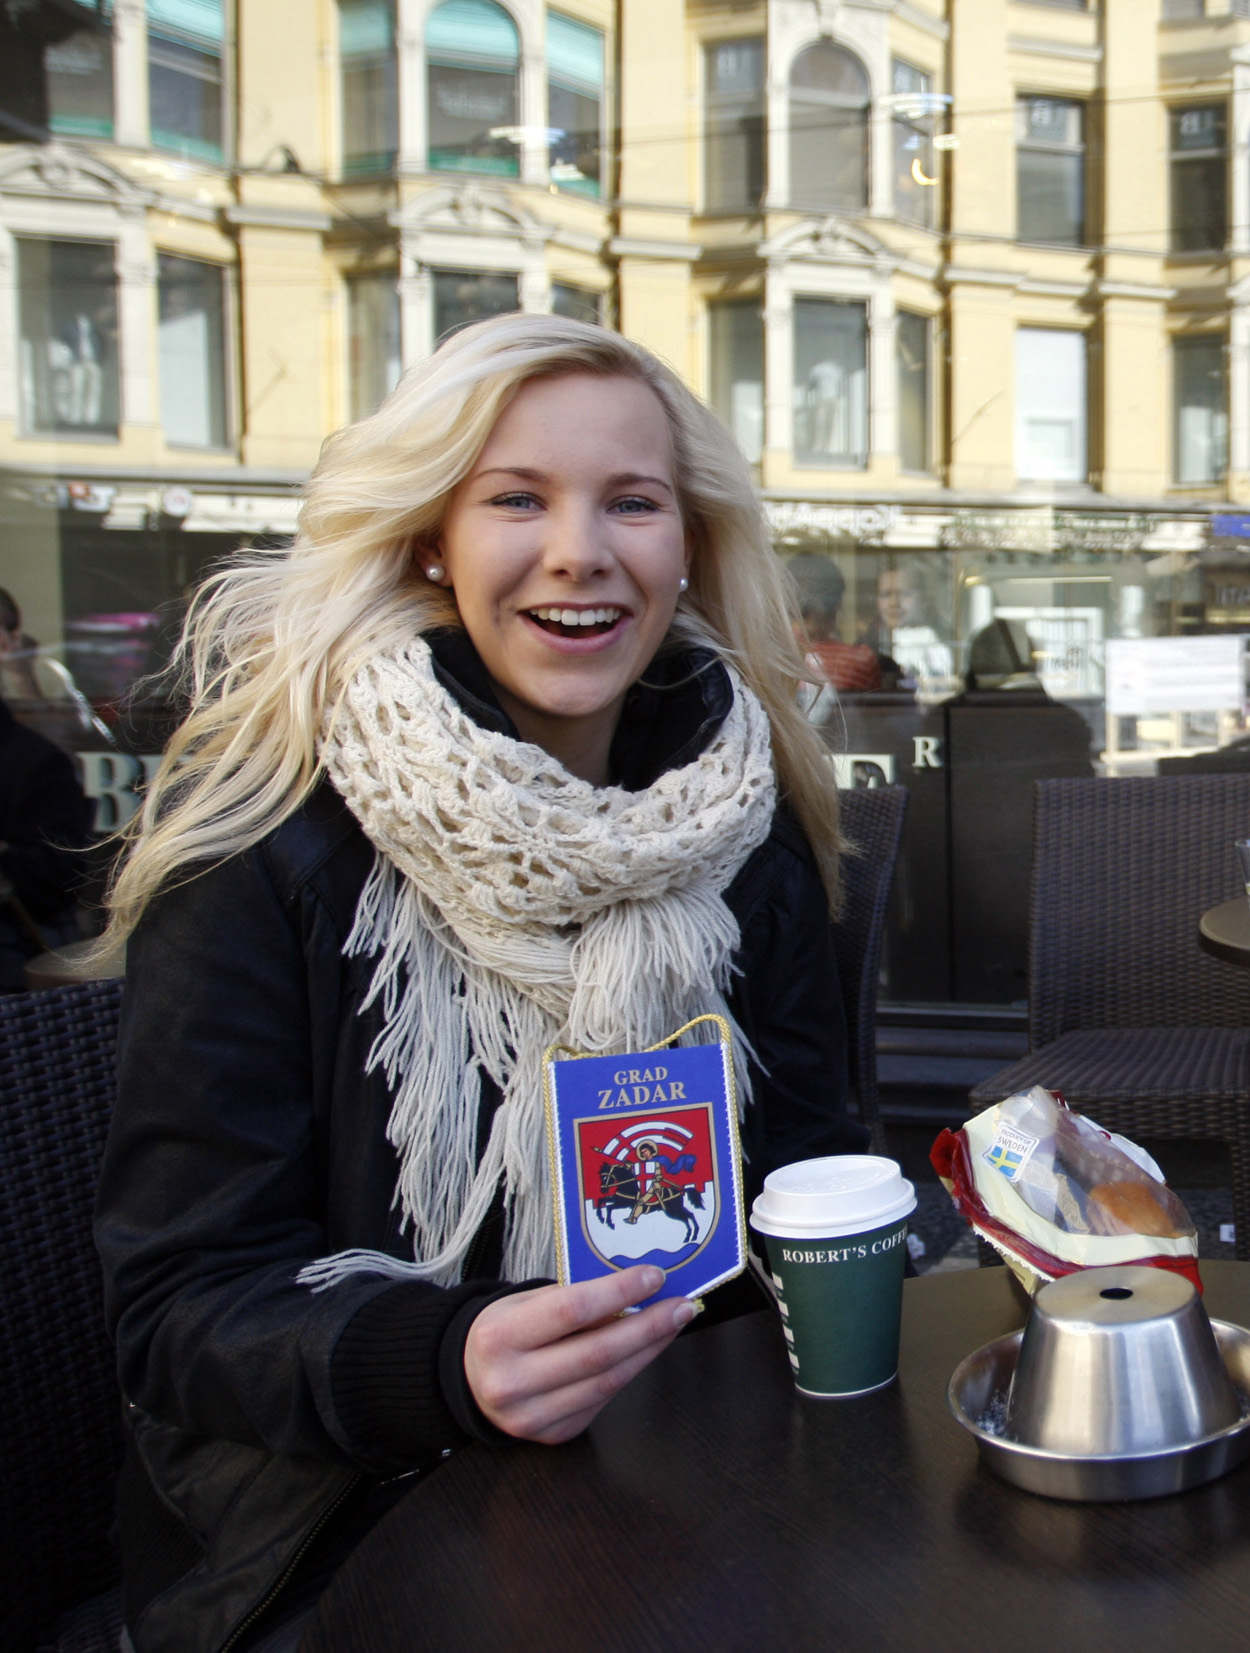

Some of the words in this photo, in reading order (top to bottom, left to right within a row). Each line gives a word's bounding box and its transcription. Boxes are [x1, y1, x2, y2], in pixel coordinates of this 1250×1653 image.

[613, 1066, 668, 1086] GRAD
[598, 1082, 687, 1110] ZADAR
[997, 1135, 1028, 1154] SWEDEN
[782, 1245, 867, 1264] ROBERT'S
